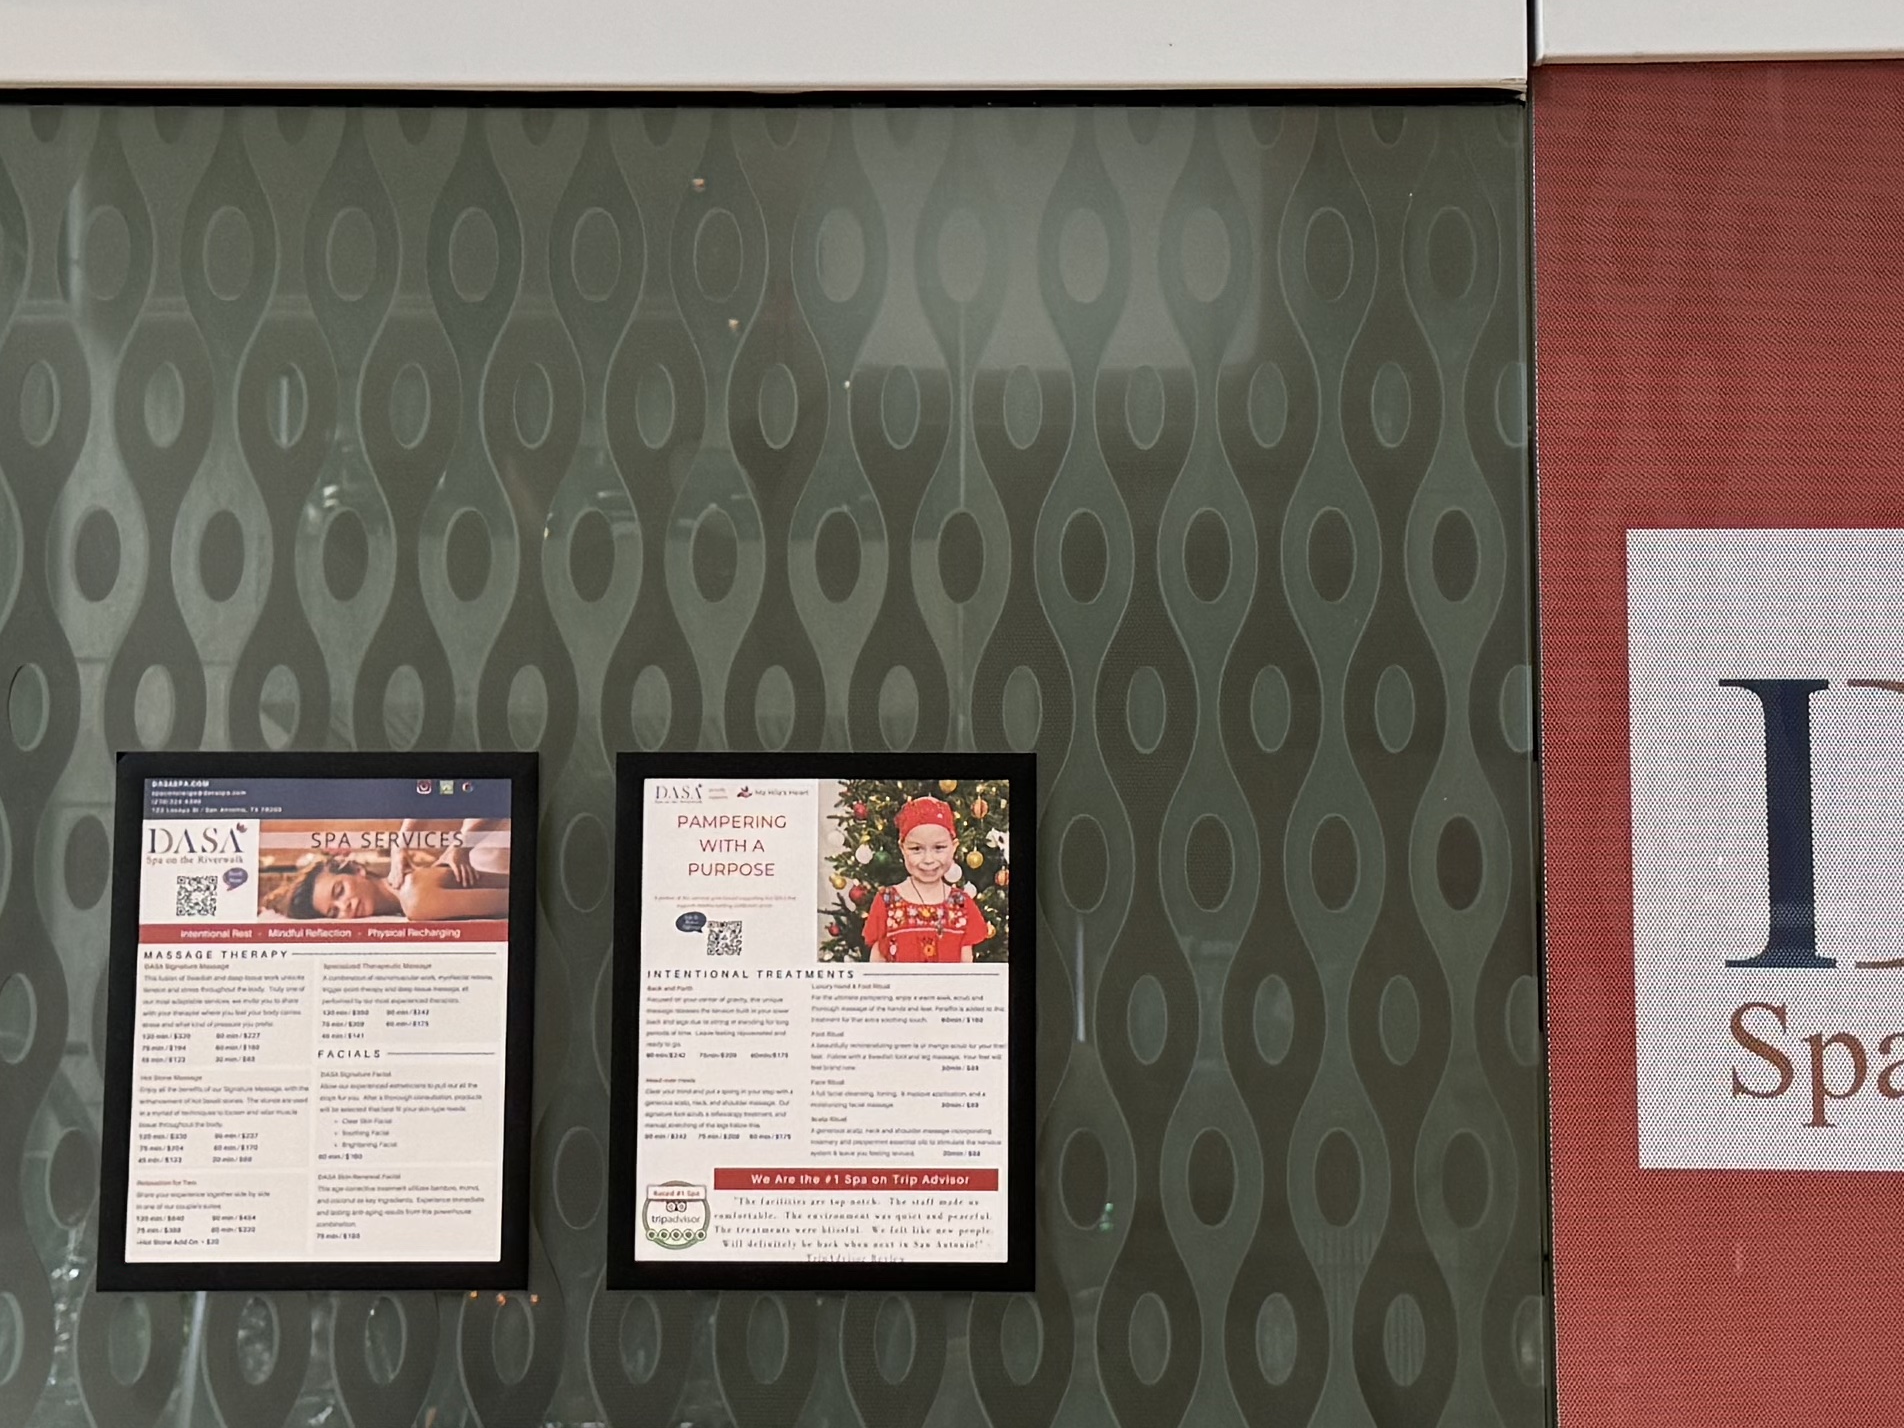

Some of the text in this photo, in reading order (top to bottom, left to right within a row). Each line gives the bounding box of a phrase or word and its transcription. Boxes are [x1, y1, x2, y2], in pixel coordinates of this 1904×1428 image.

[656, 785, 702, 800] DASA
[677, 815, 787, 829] PAMPERING
[147, 827, 245, 854] DASA
[311, 831, 465, 849] SPA SERVICES
[699, 839, 765, 853] WITH A
[146, 855, 163, 866] Spa
[180, 856, 194, 864] the
[197, 855, 244, 864] Riverwalk
[688, 862, 775, 877] PURPOSE
[181, 928, 461, 940] Intentional Rest Mindful Reflection Physical Recharging
[143, 950, 288, 959] MASSAGE THERAPY
[647, 970, 854, 979] INTENTIONAL TREATMENTS
[317, 1049, 381, 1059] FACIALS
[751, 1174, 969, 1187] We Are the #1 Spa on Trip Advisor
[889, 1197, 906, 1205] The
[912, 1197, 934, 1205] staff
[652, 1214, 700, 1225] tripadvisor
[785, 1211, 802, 1220] The
[715, 1226, 731, 1234] The
